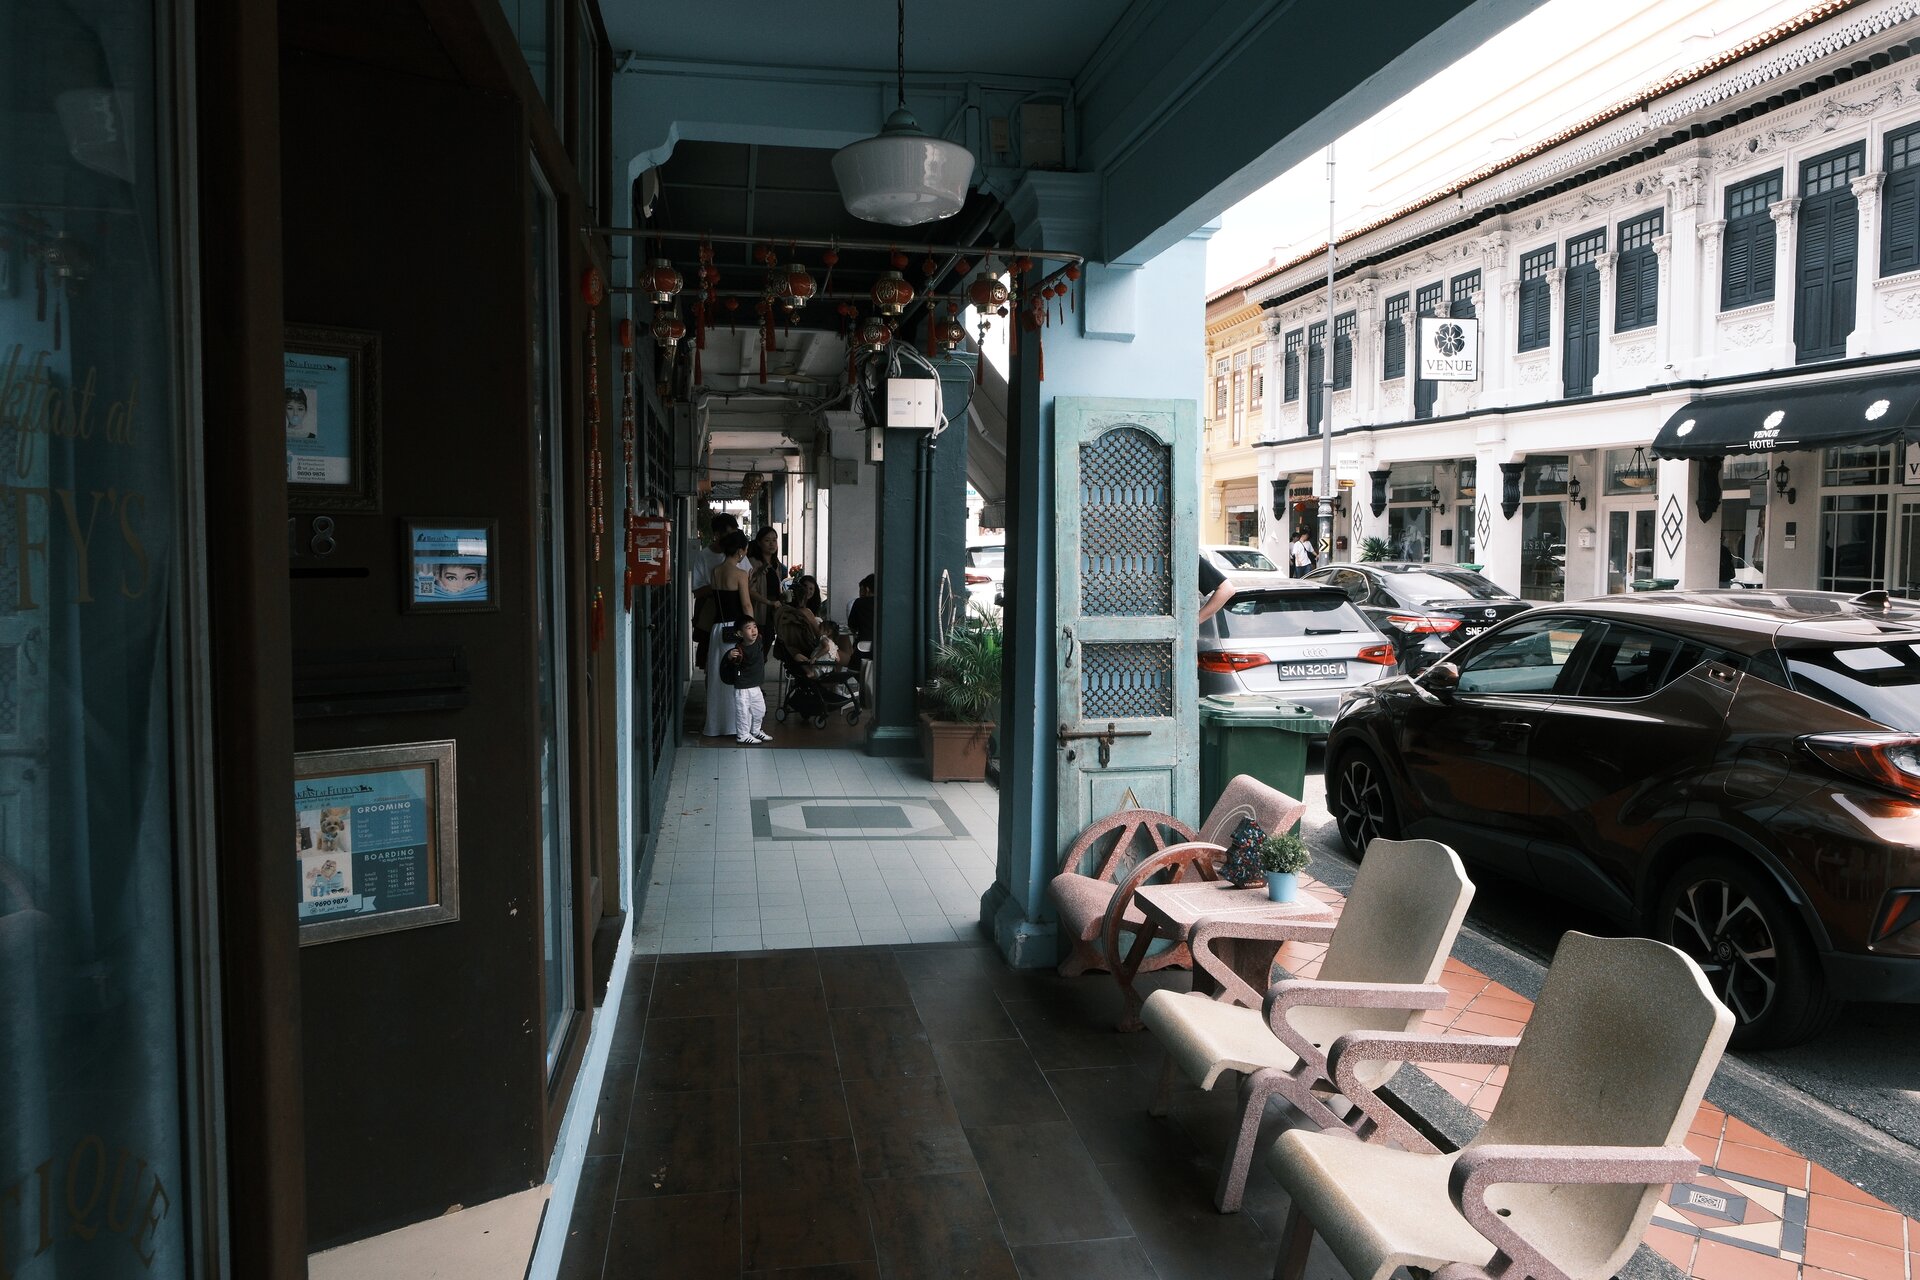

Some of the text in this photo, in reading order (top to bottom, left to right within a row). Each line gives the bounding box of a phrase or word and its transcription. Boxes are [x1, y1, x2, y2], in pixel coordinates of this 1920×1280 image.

[1426, 360, 1474, 371] VENUE
[1753, 429, 1781, 439] VENUE
[1748, 439, 1777, 449] HOTEL
[0, 485, 150, 610] FY'S
[1281, 664, 1346, 676] SKN3206A
[357, 801, 411, 814] GROOMING
[364, 848, 415, 862] BOARDING
[315, 900, 332, 908] 9690
